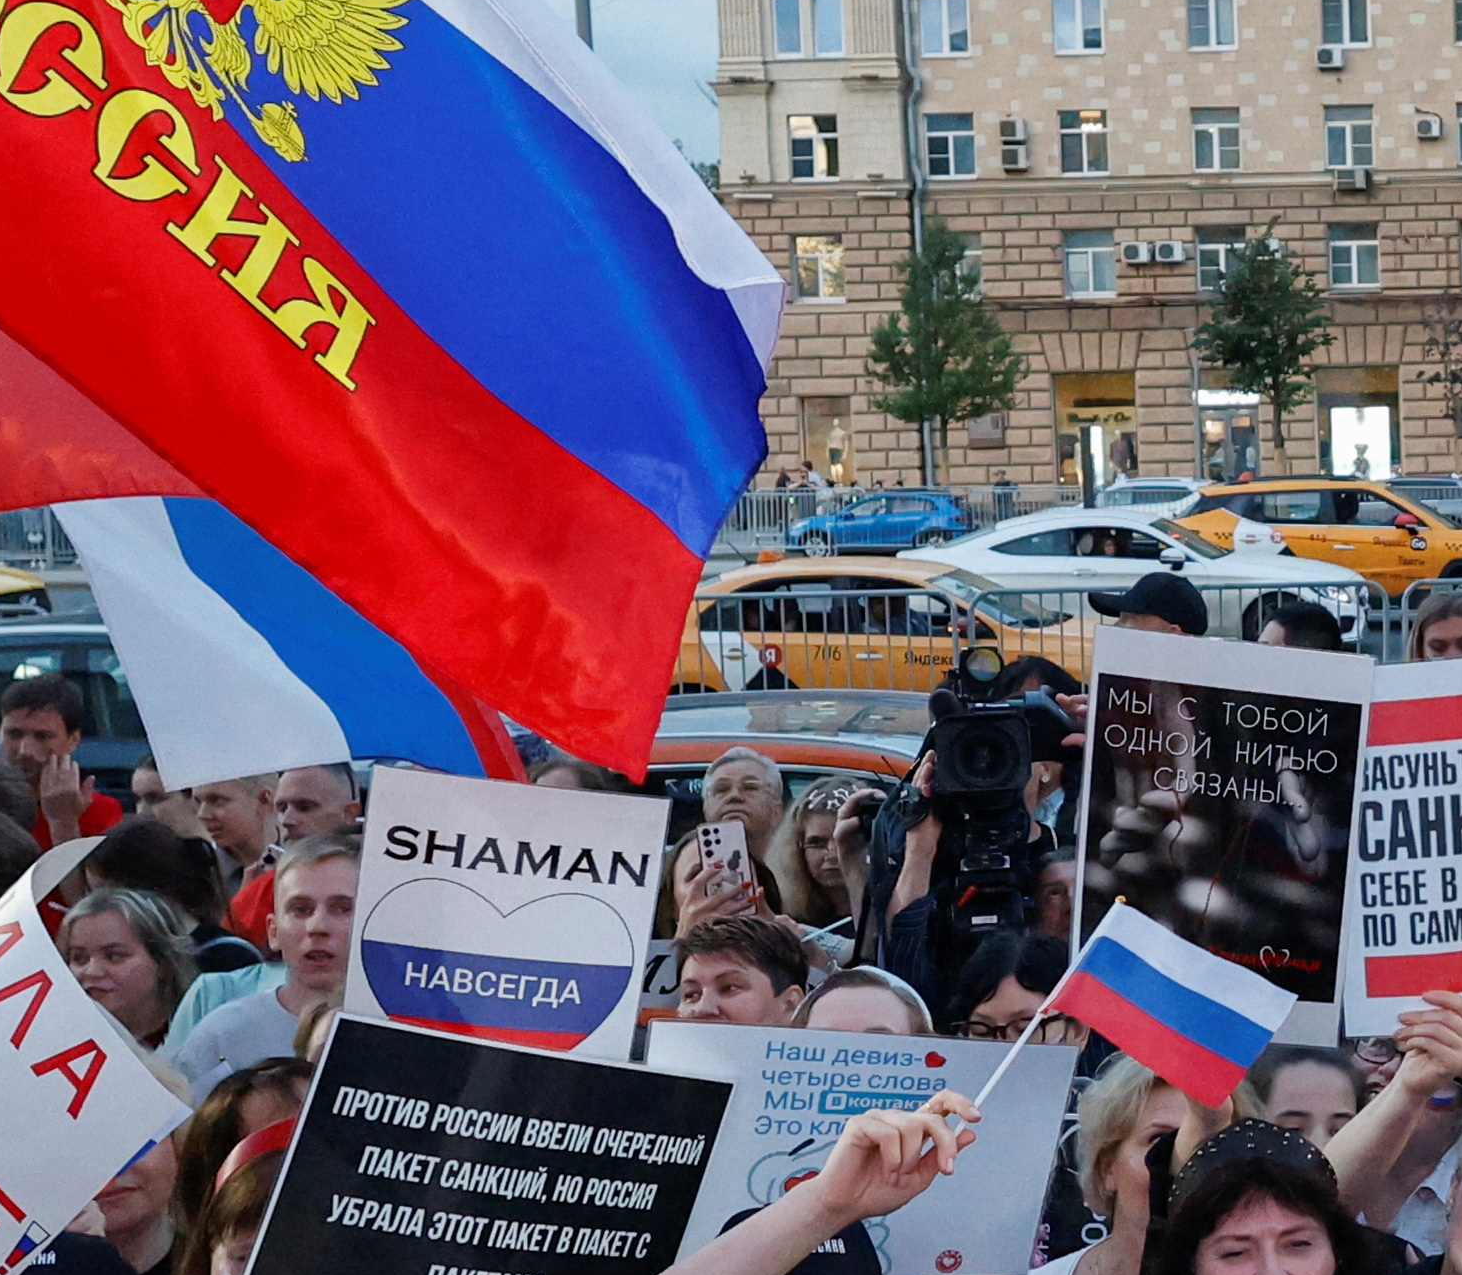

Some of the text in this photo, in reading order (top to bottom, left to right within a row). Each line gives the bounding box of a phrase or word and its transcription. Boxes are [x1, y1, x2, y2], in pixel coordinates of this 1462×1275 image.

[1107, 687, 1330, 738] МЫ С ТОБОЙ
[1103, 723, 1338, 774] ОДНОЙ НИТЬЮ
[384, 825, 650, 887] SHAMAN
[1360, 868, 1428, 909] СЕБЕ
[1441, 866, 1457, 902] В
[1363, 913, 1397, 948] ПО
[404, 961, 581, 1007] НАВСЕГДА
[765, 1040, 923, 1068] Наш девиз-
[762, 1069, 946, 1092] четыре слова
[763, 1091, 814, 1111] МЫ
[333, 1086, 706, 1166] ПРОТИВ РОССИИ ВВЕЛИ ОЧЕРЕДНОЙ
[754, 1115, 803, 1136] Это
[357, 1145, 658, 1211] ПАКЕТ САНКЦИЙ, НО РОССИЯ
[327, 1194, 651, 1259] УБРАЛА ЭТОТ ПАКЕТ В ПАКЕТ С
